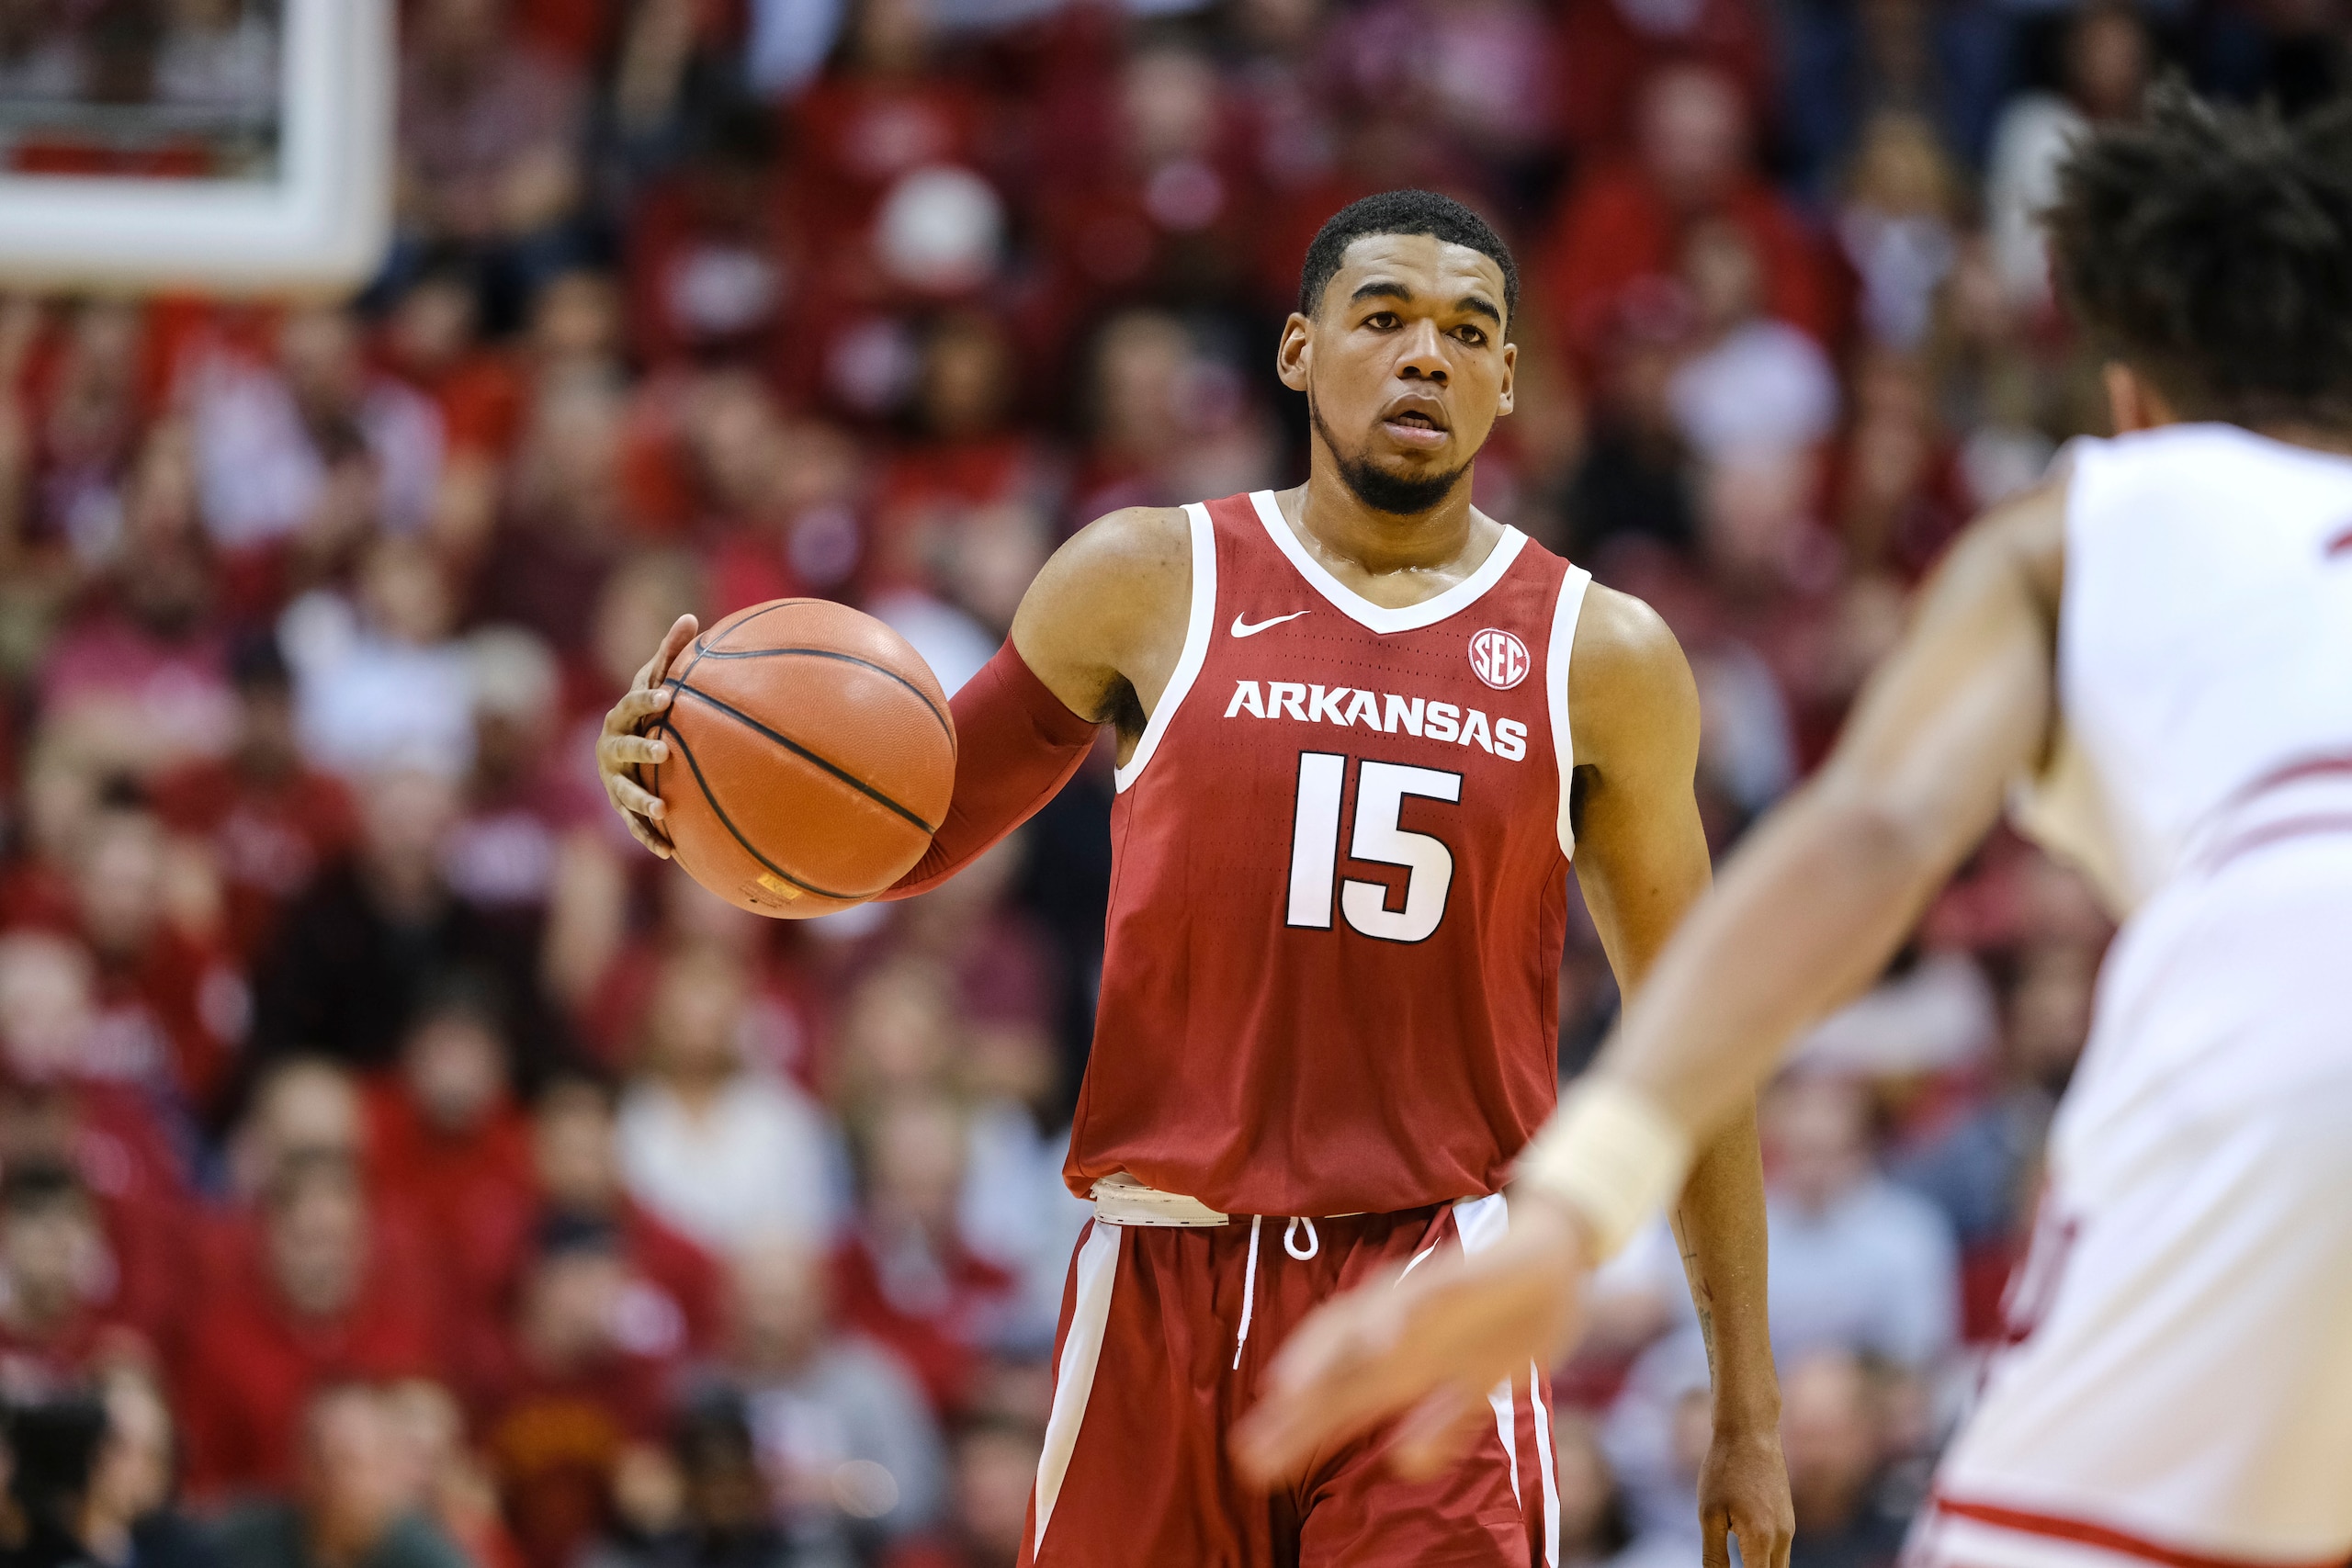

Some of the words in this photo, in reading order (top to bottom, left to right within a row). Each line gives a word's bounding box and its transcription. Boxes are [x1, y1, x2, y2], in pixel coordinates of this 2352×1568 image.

[1475, 628, 1522, 684] SEC
[1224, 680, 1528, 761] ARKANSAS
[1284, 750, 1464, 944] 15
